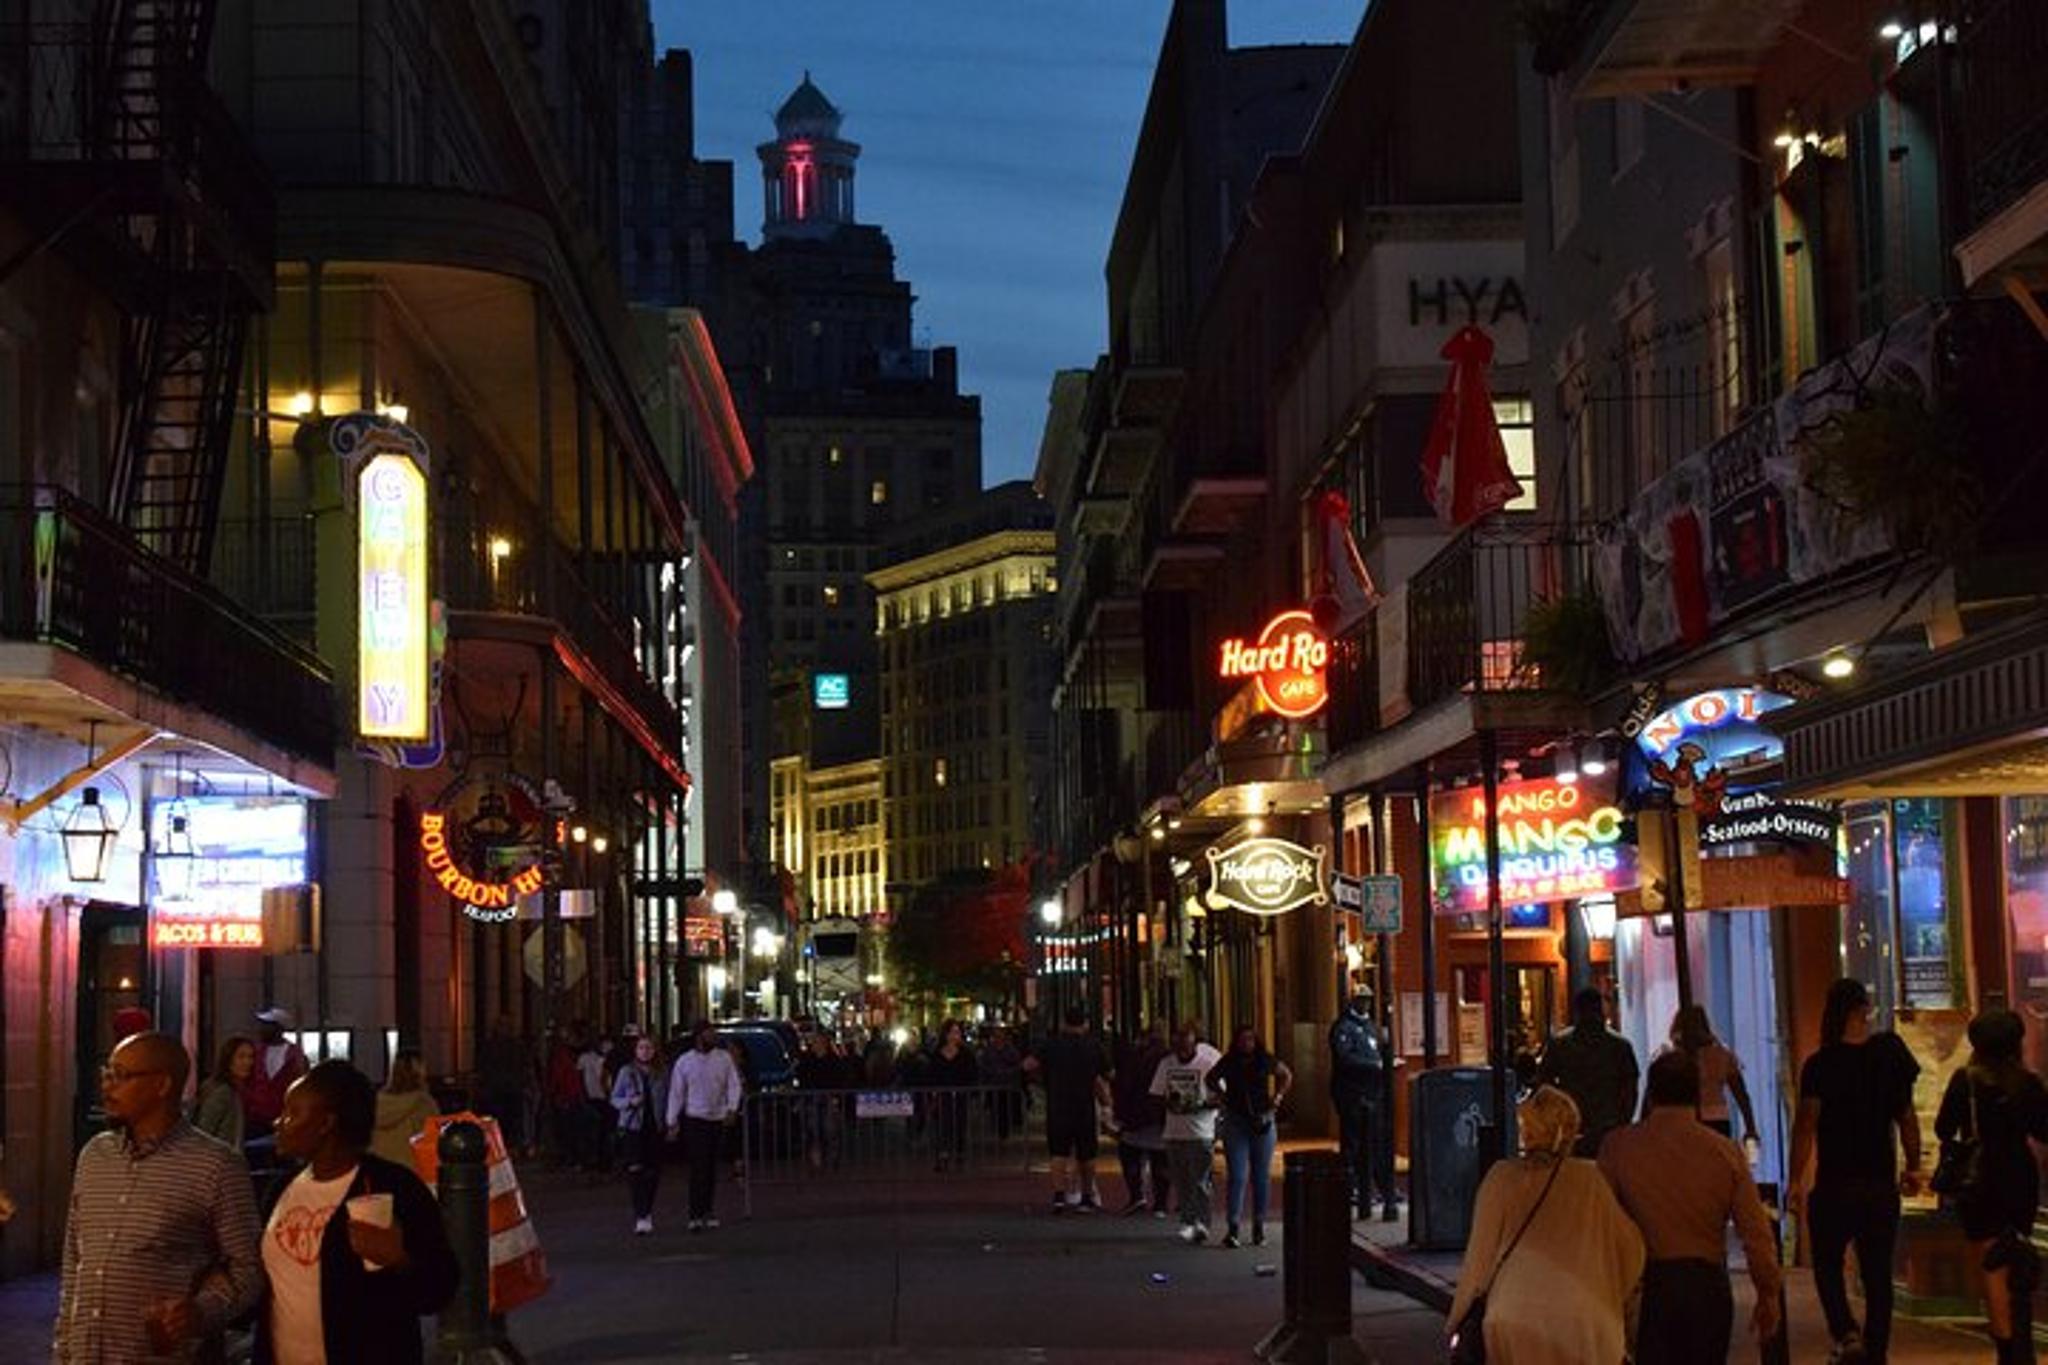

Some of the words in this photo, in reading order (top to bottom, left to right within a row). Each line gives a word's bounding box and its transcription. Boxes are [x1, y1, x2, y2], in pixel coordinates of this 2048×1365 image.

[1409, 276, 1529, 326] HYA
[1219, 633, 1290, 677] Hard
[1291, 631, 1328, 676] Ro
[1472, 786, 1579, 821] MANGO
[419, 811, 510, 908] BOURBON
[1220, 859, 1268, 881] Hard
[1268, 858, 1313, 884] Rock
[1459, 846, 1619, 886] DIQUIRIS
